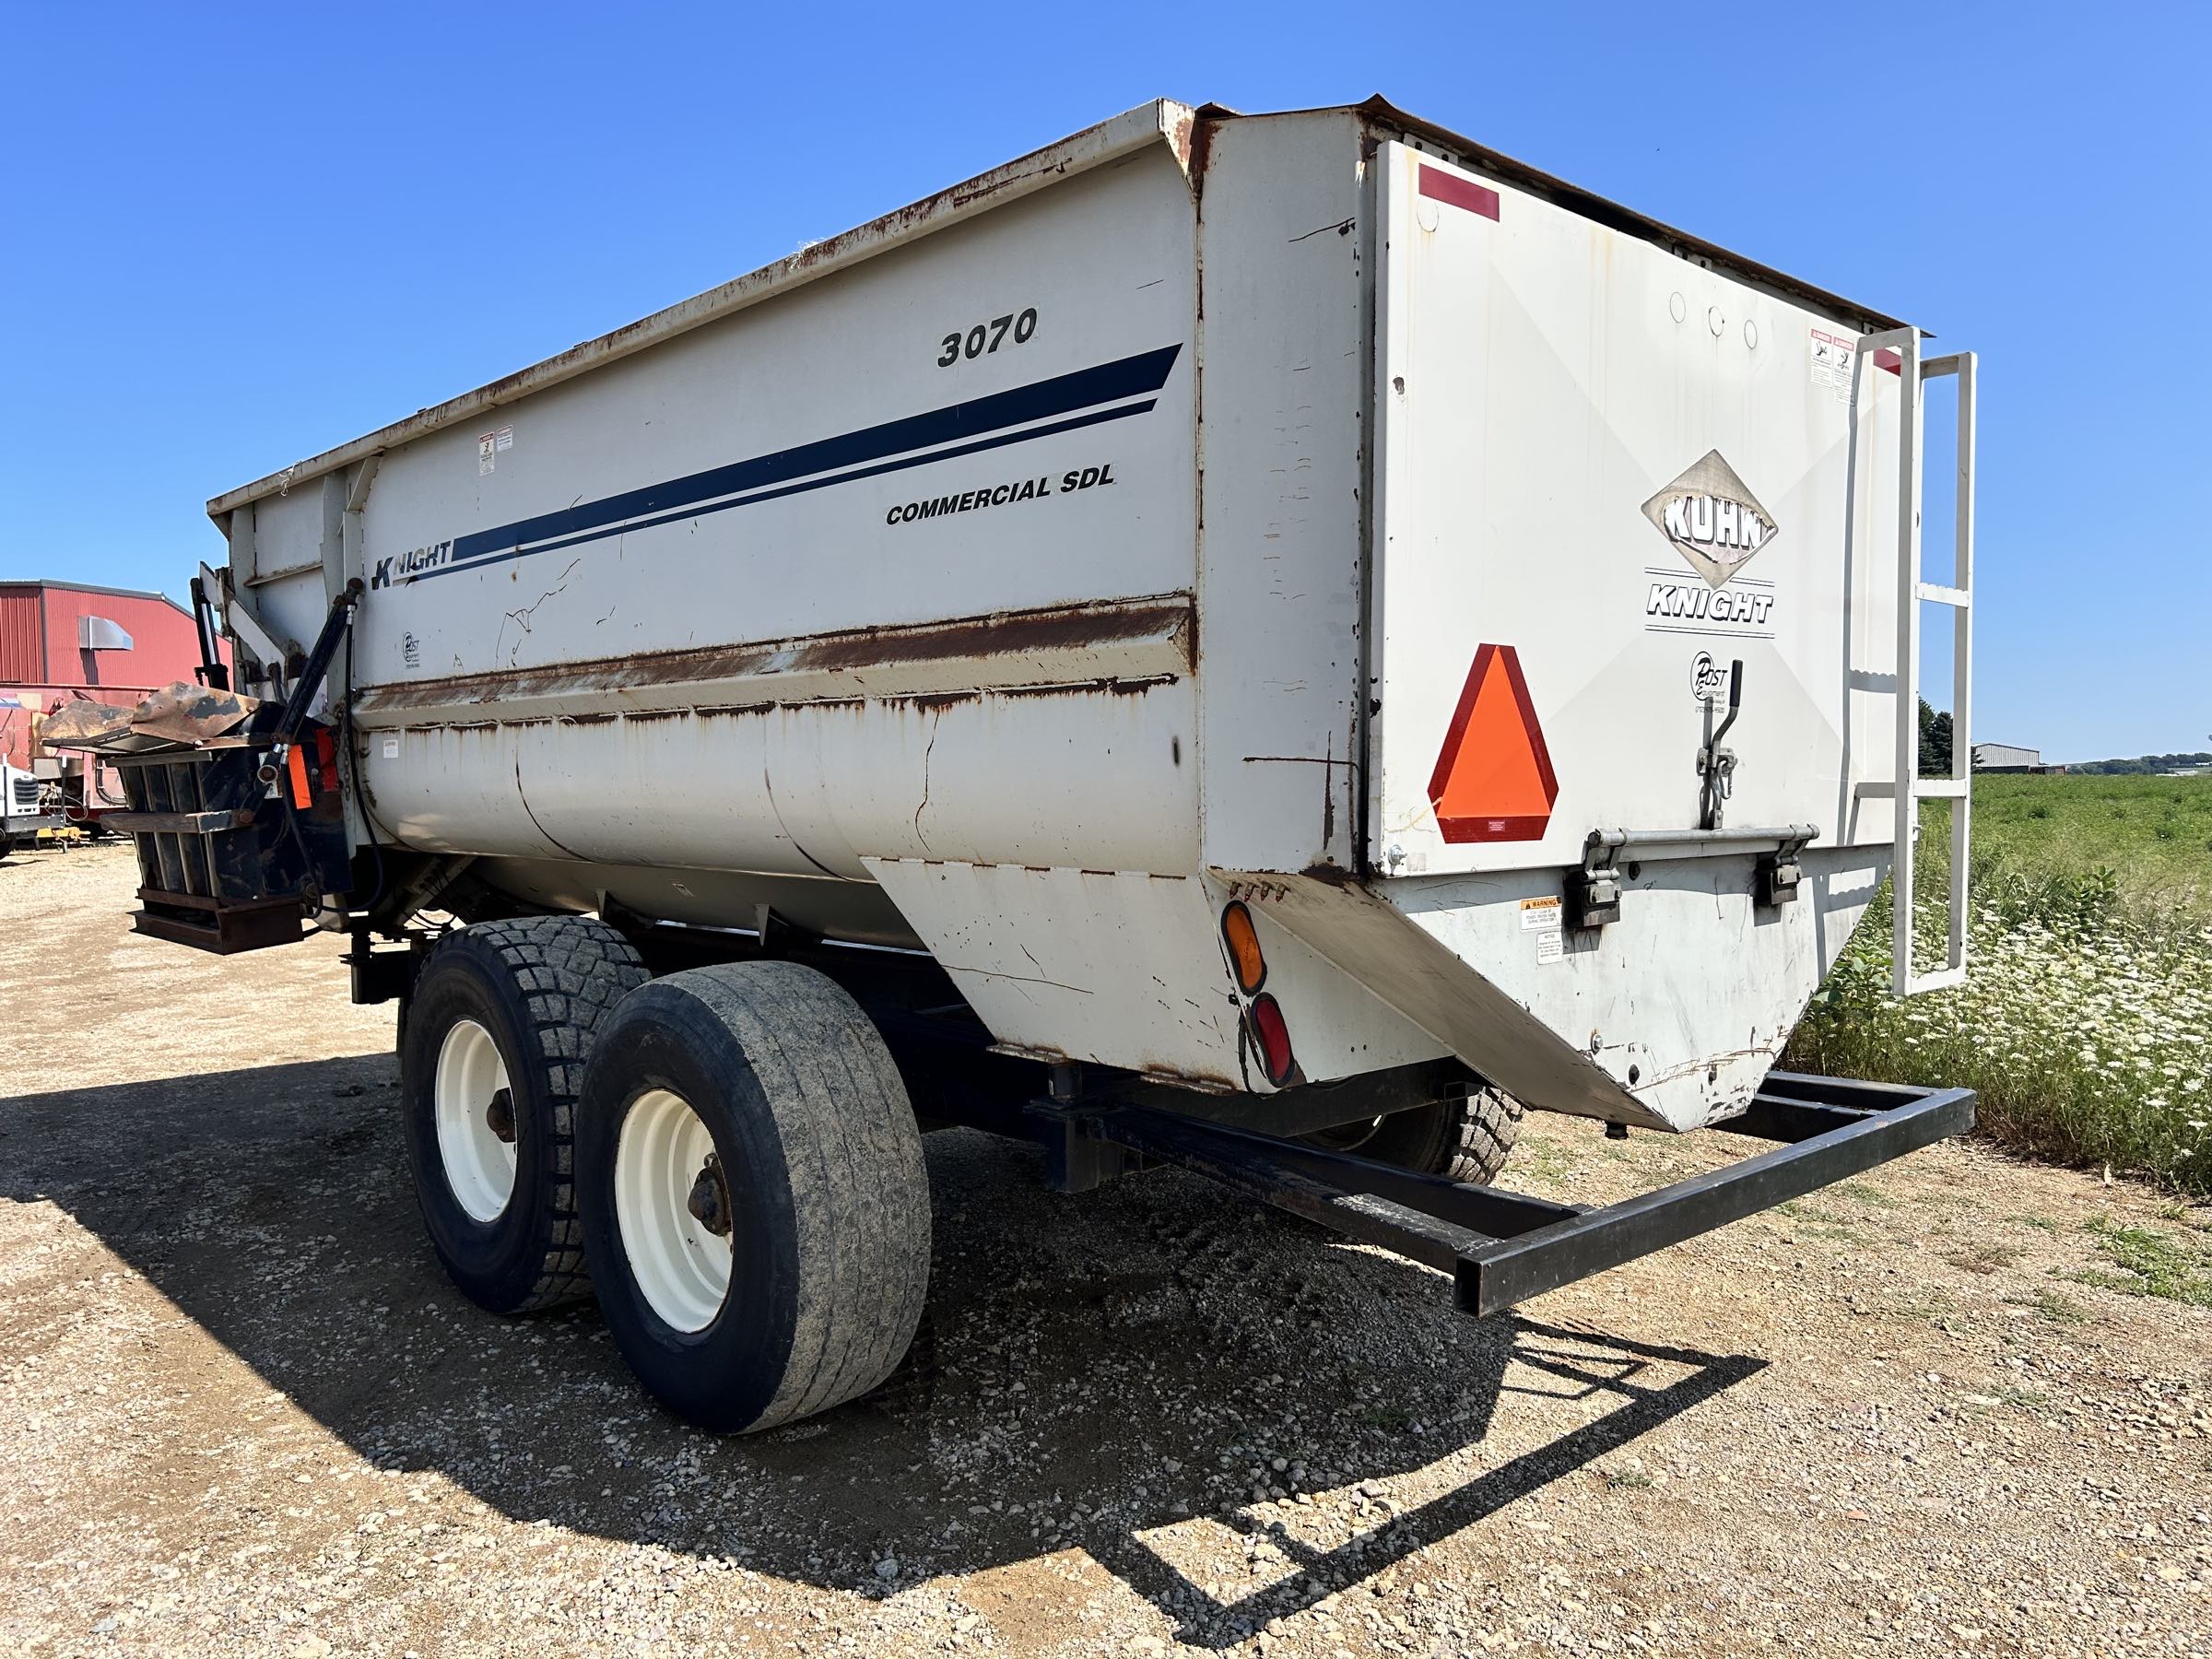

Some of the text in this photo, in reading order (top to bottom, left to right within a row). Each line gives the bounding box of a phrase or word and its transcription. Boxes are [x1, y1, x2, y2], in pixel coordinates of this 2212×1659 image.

[936, 307, 1038, 369] 3070
[885, 464, 1115, 525] COMMERCIAL SDL
[1664, 494, 1765, 551] KUHN
[371, 540, 452, 591] KNIGHT
[1645, 583, 1774, 624] KNIGHT
